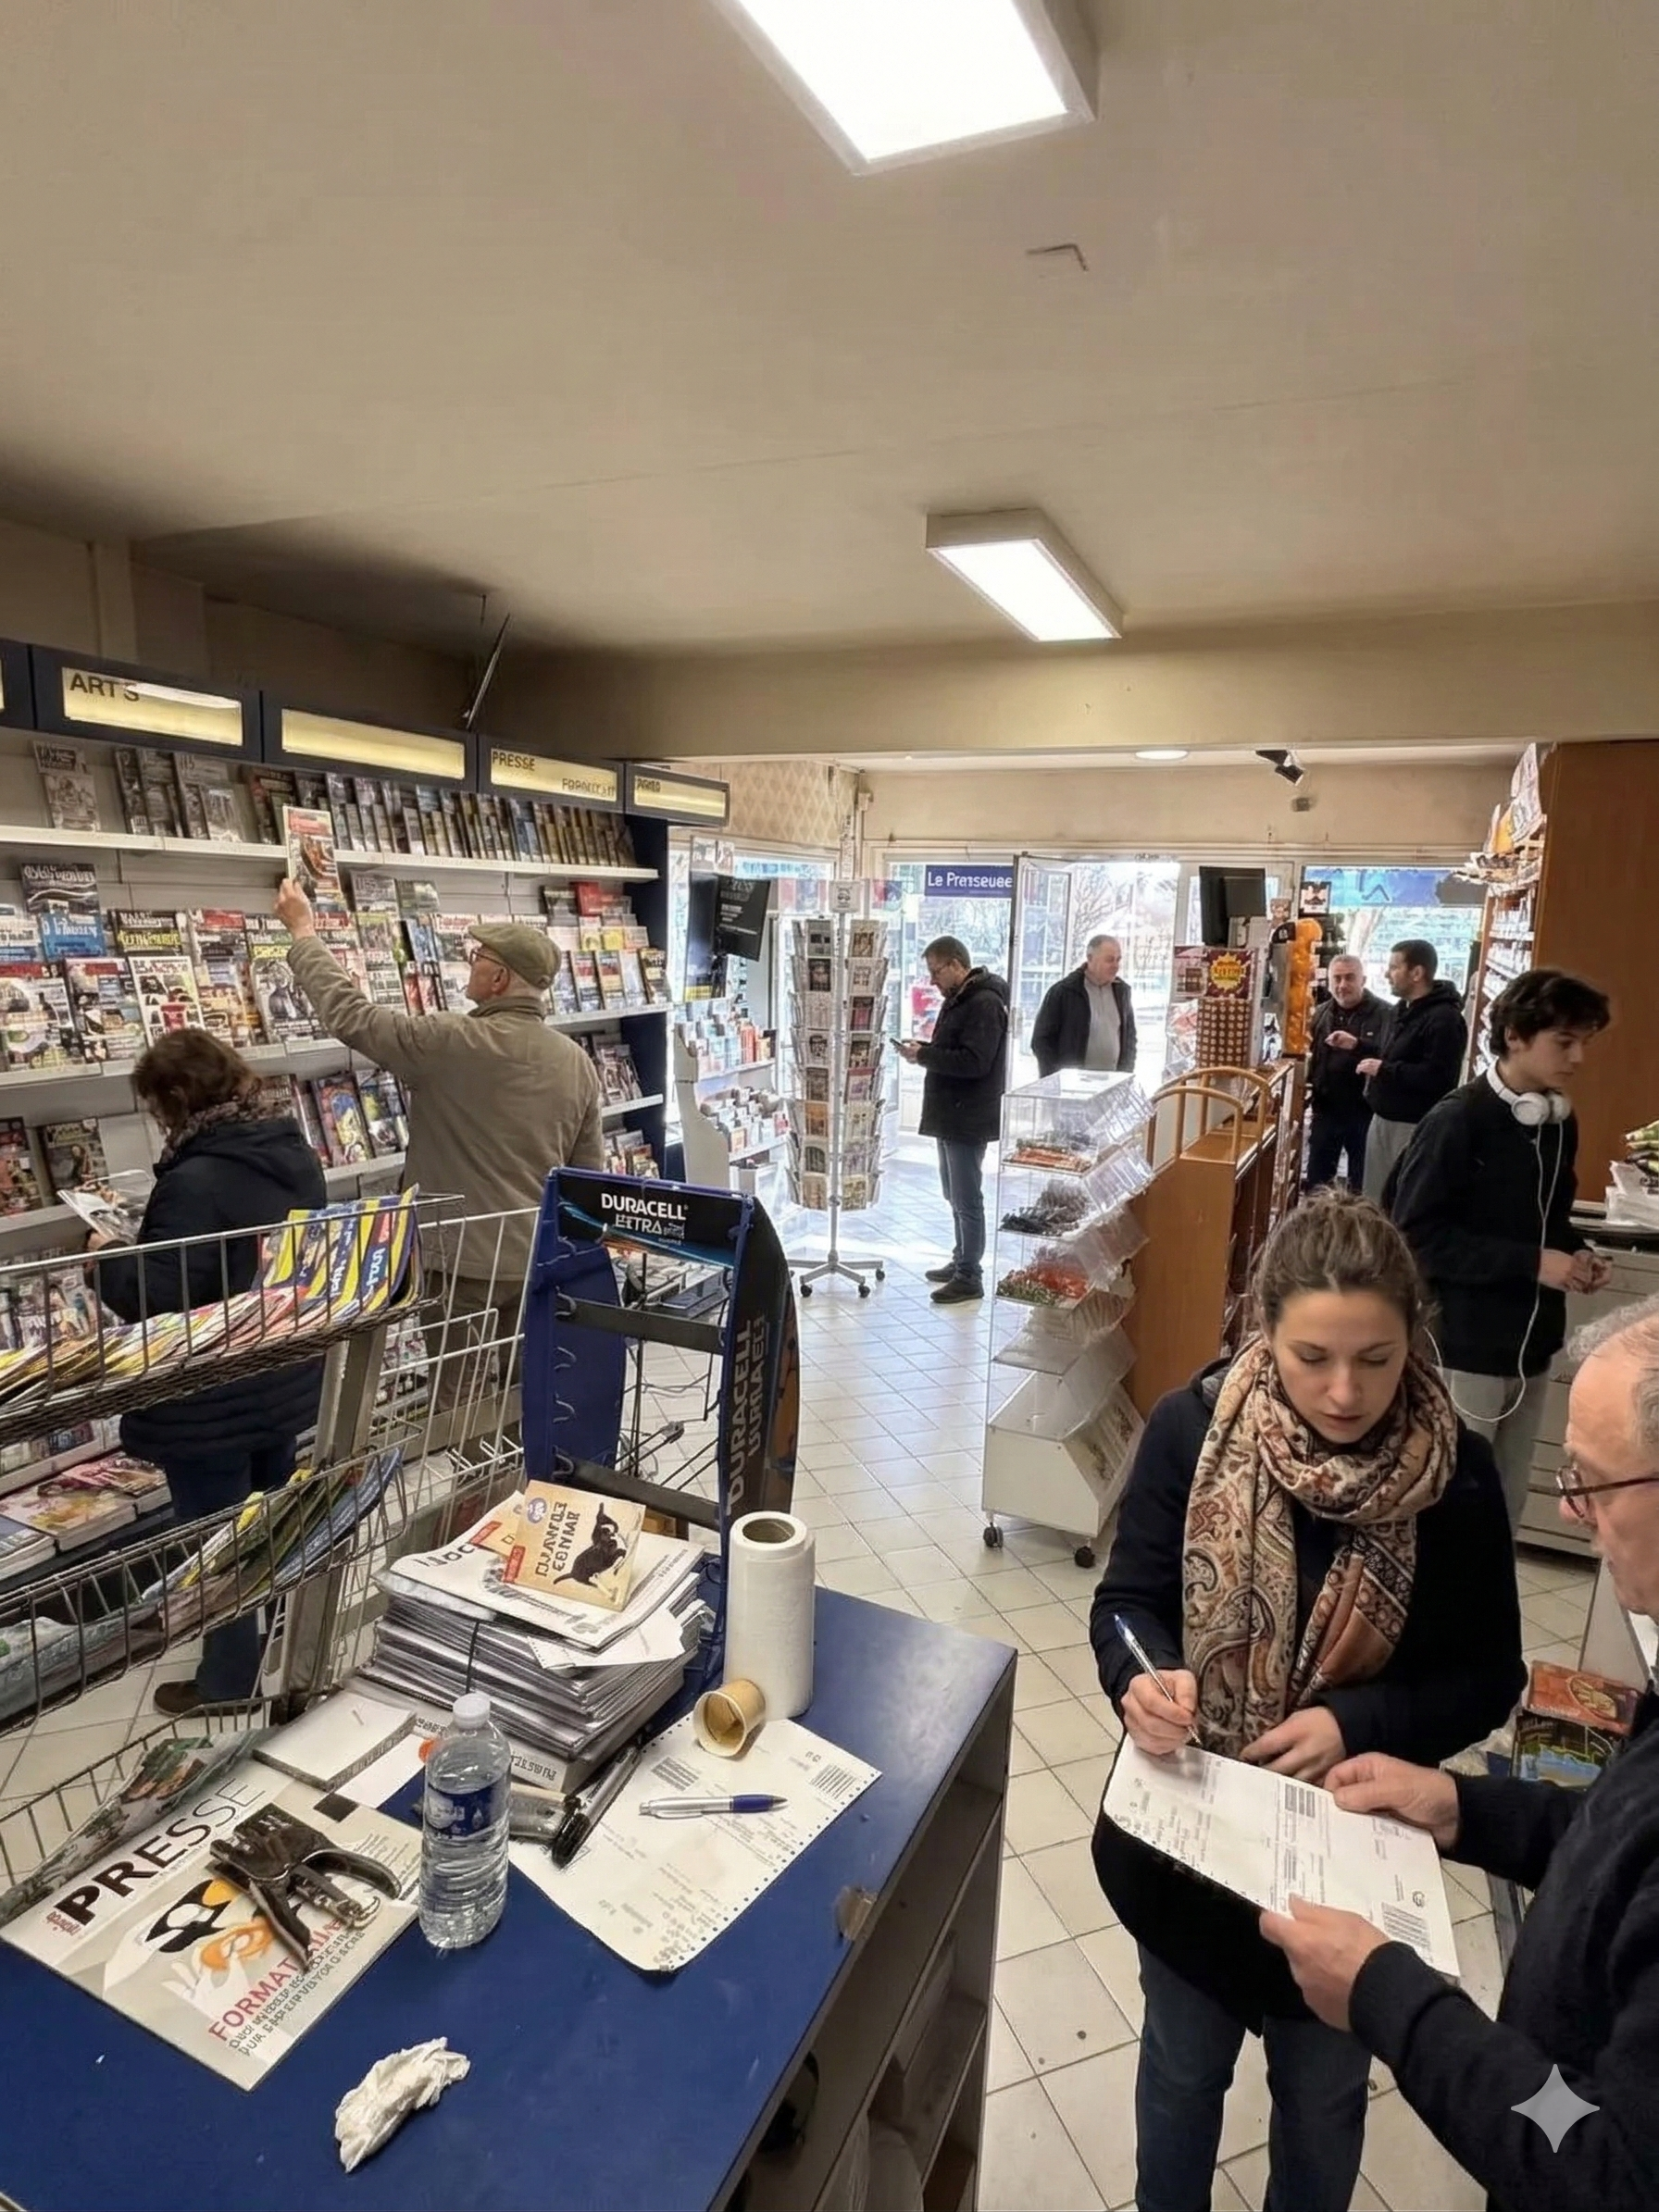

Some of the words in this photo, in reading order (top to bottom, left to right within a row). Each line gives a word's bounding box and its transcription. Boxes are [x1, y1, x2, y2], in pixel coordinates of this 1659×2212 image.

[69, 672, 140, 702] ARTS
[492, 751, 536, 772] PRESSE
[601, 1192, 687, 1222] DURACELL
[54, 1777, 267, 1927] PRESSE
